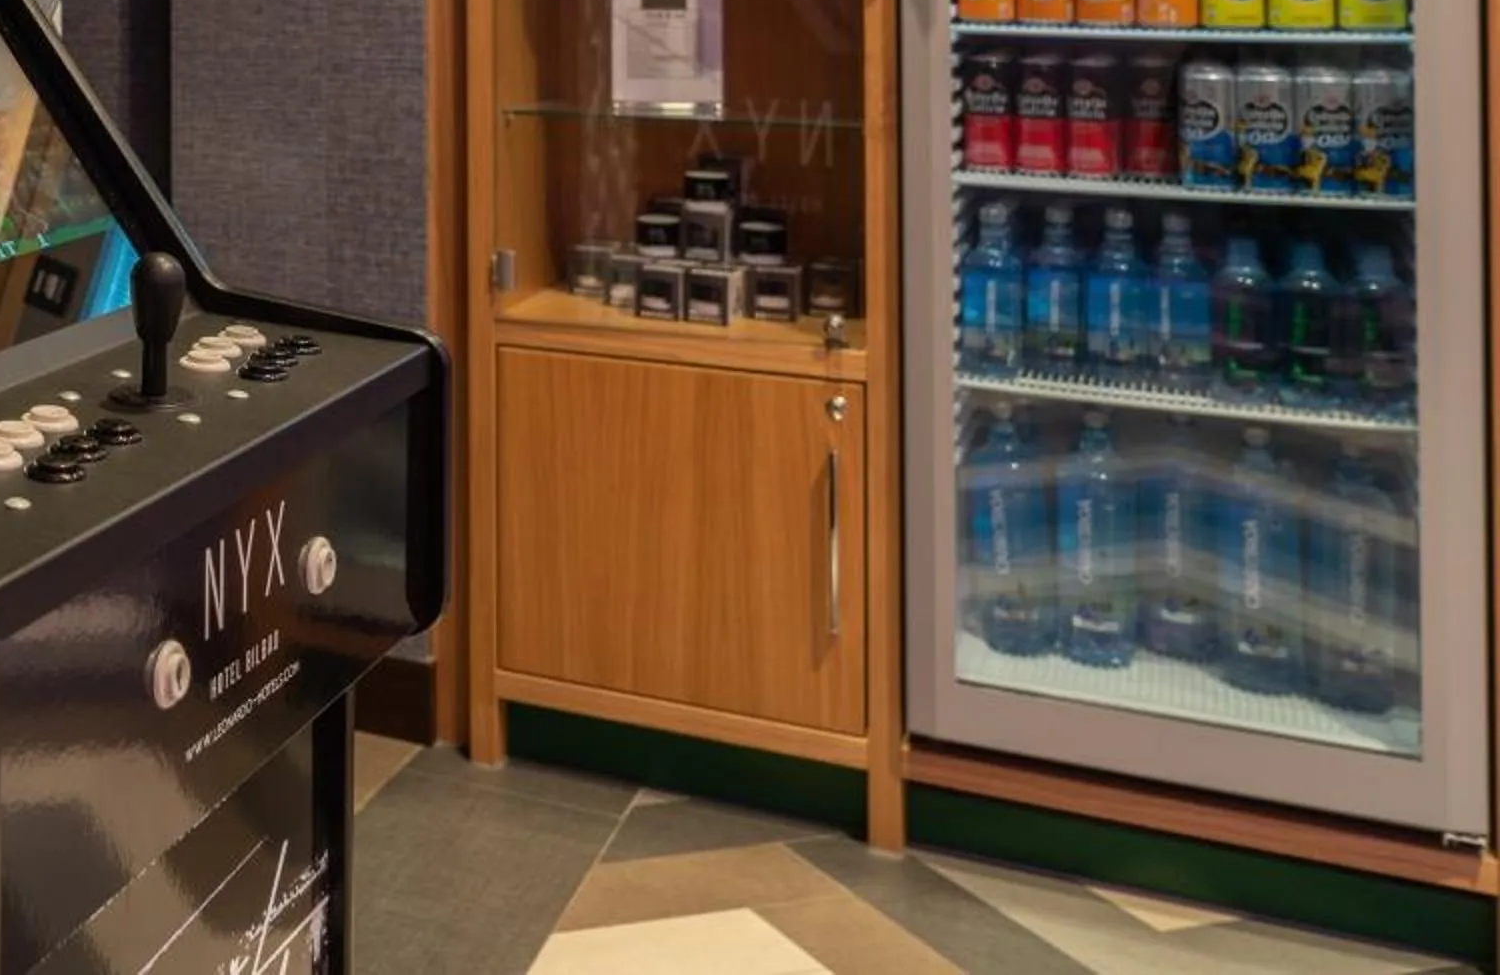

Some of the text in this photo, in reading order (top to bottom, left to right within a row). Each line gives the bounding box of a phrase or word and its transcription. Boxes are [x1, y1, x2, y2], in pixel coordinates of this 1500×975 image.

[204, 499, 286, 642] NYX
[209, 628, 280, 701] HOTEL BILBAO
